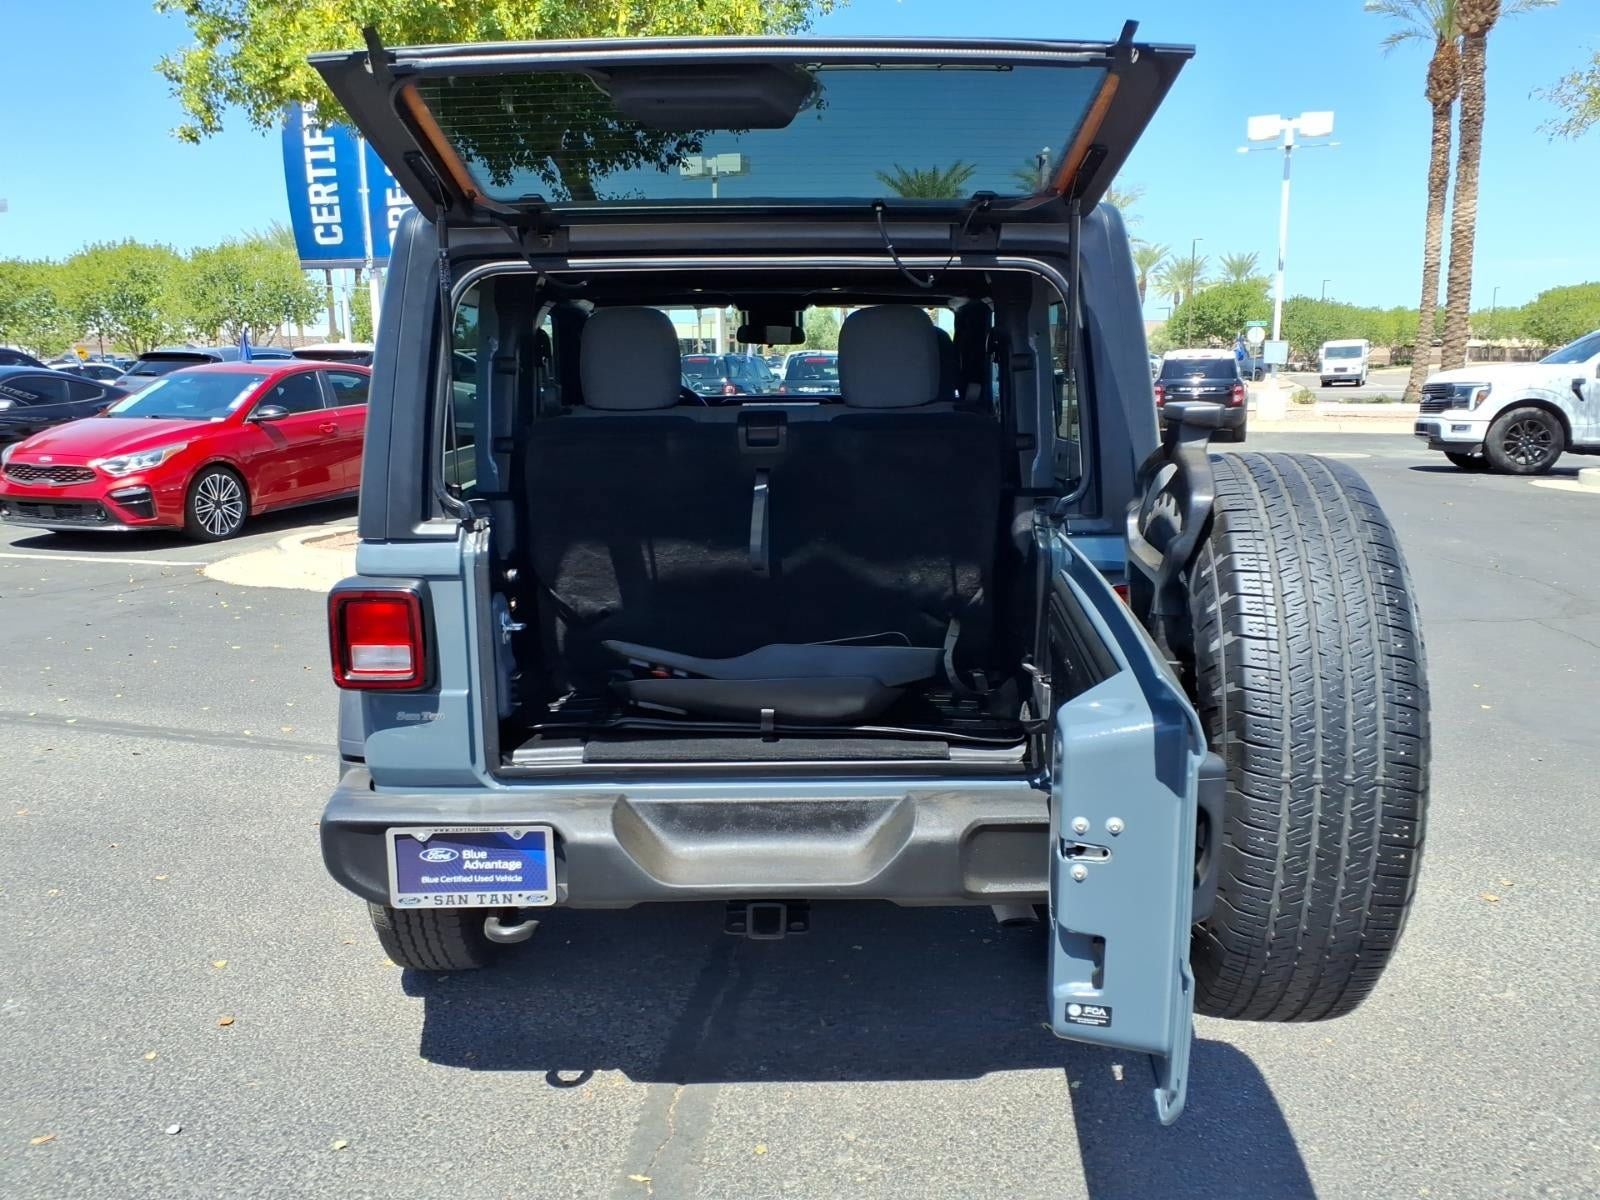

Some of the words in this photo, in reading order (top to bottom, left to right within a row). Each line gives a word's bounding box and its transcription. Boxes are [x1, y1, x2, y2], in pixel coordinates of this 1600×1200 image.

[462, 849, 487, 859] Blue
[463, 860, 522, 870] Advantage
[421, 876, 439, 884] Blue
[440, 874, 473, 883] Certified
[474, 874, 494, 882] Used
[495, 874, 523, 882] Vehicle
[433, 894, 469, 905] SAN
[477, 893, 513, 904] TAN
